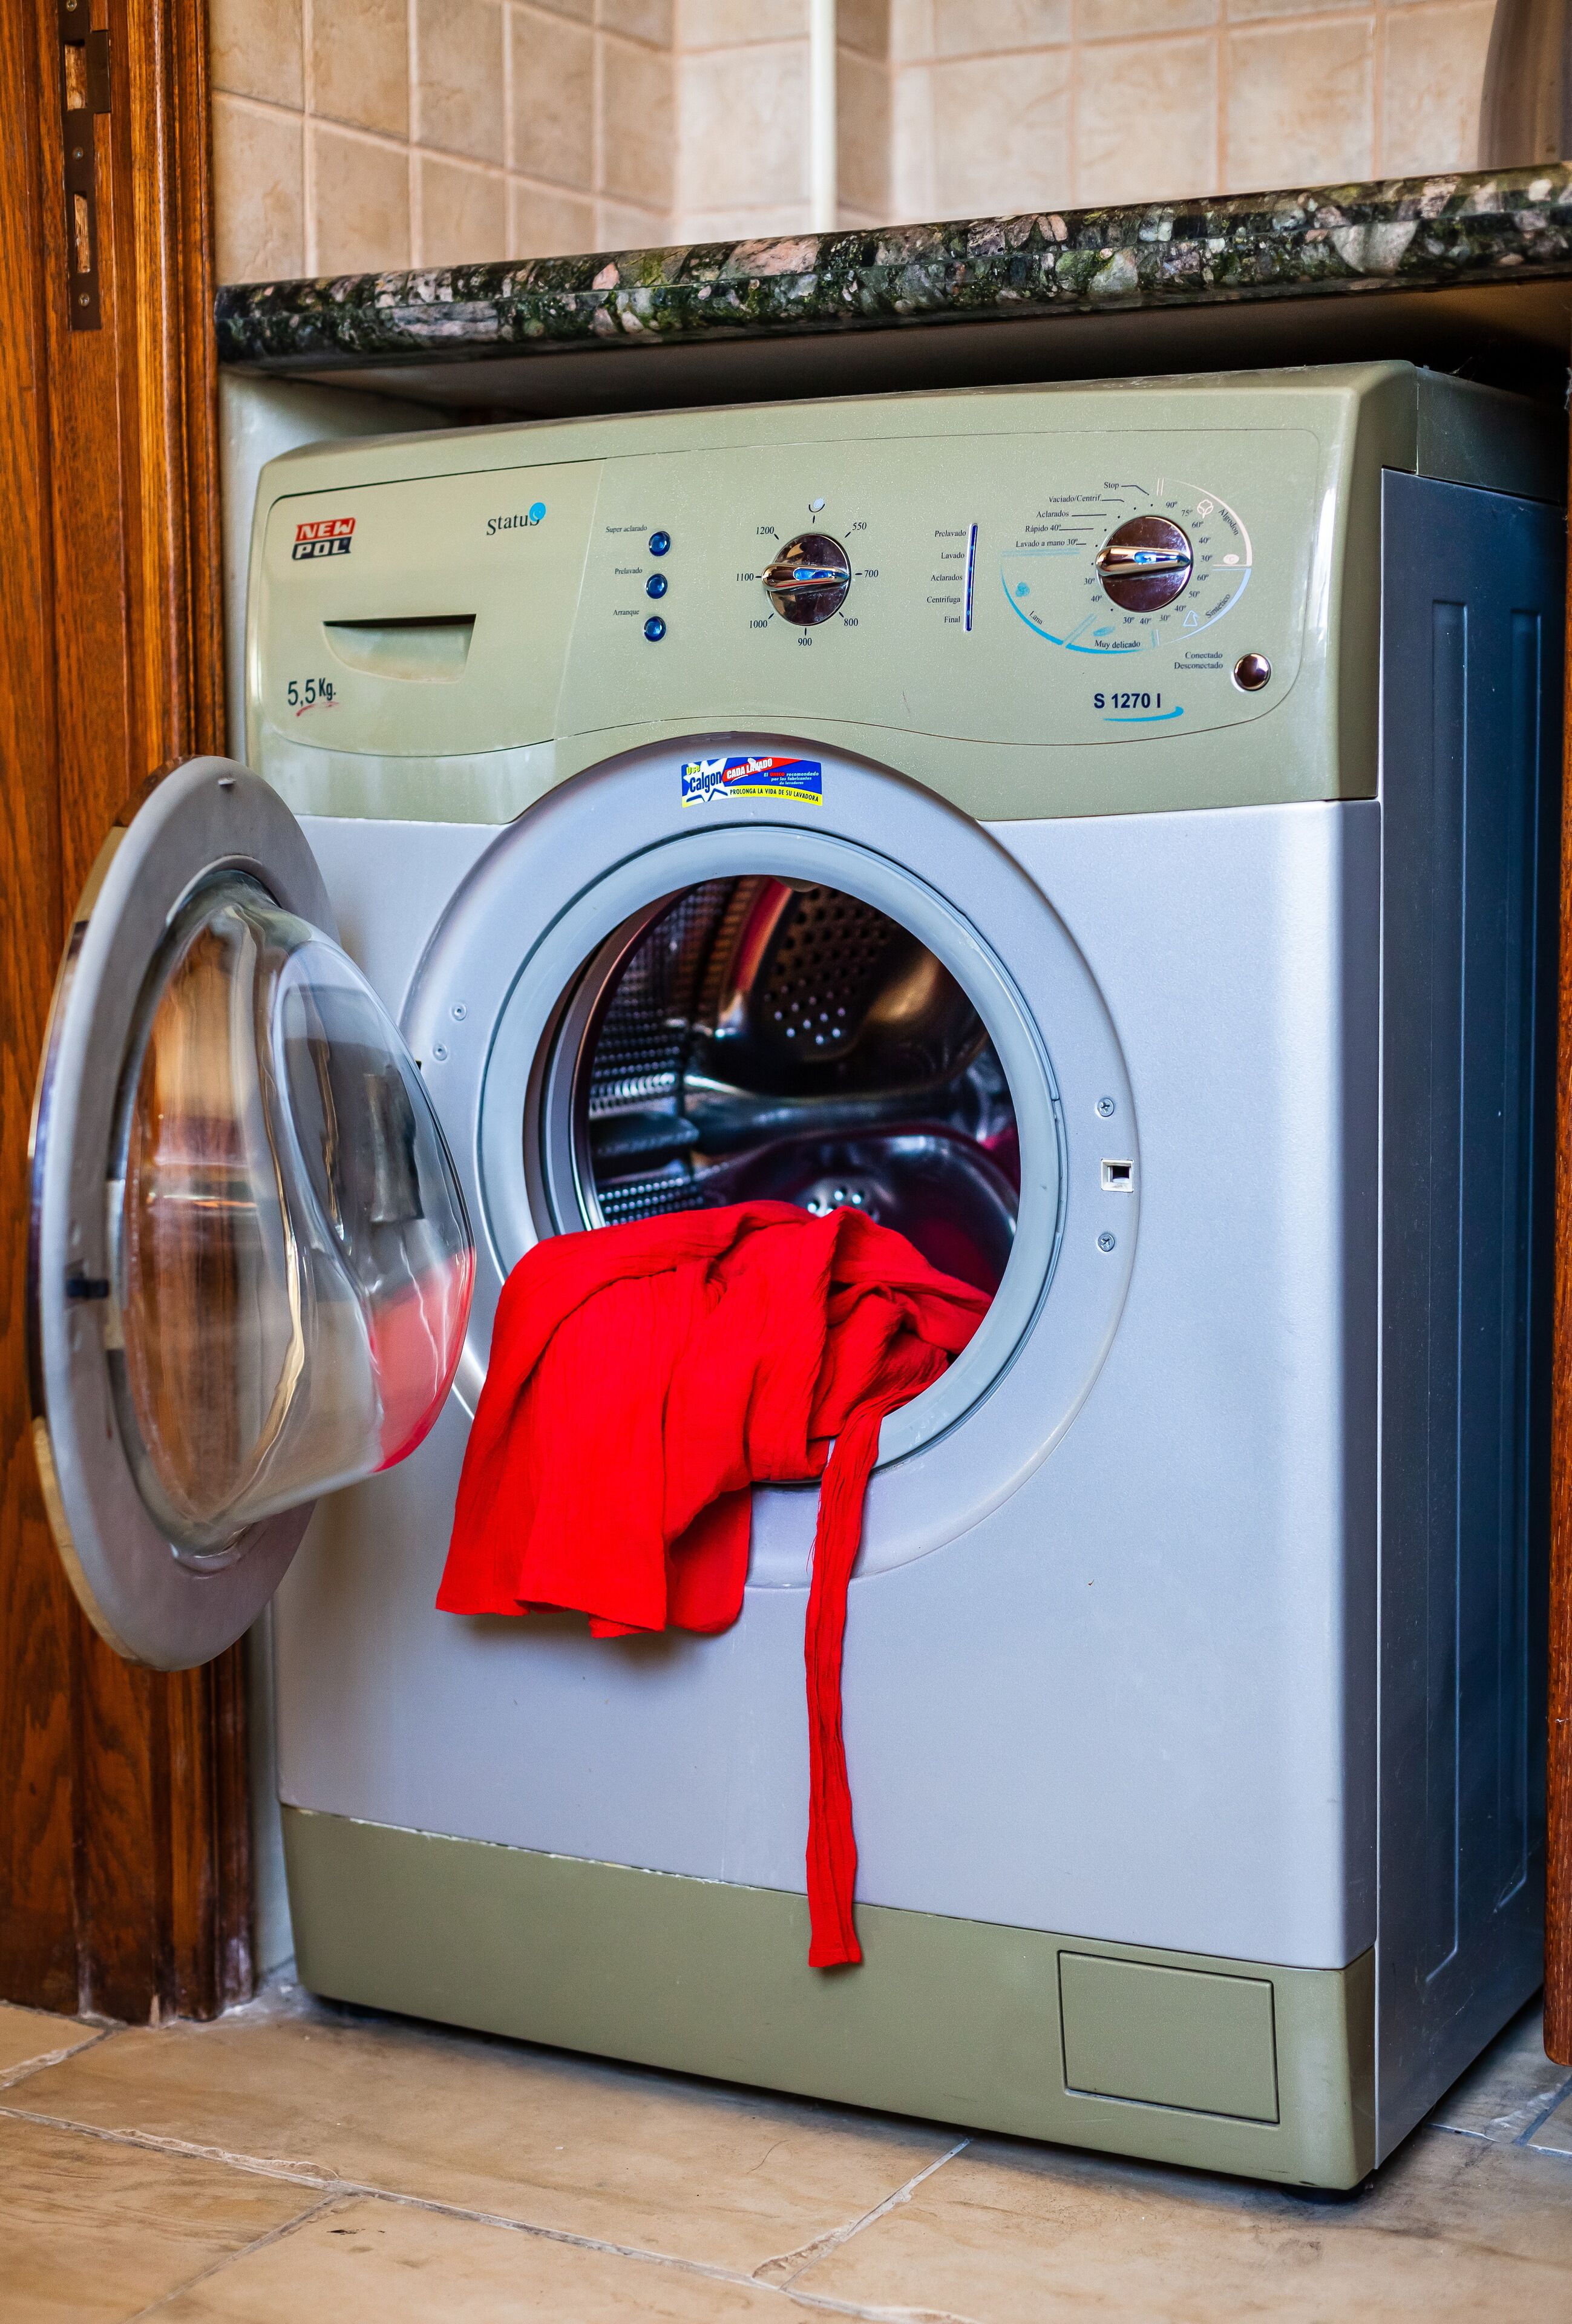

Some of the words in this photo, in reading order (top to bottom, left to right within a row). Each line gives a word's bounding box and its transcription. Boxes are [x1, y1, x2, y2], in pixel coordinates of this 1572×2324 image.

[1104, 482, 1119, 490] Stop
[299, 519, 353, 539] NEW
[756, 526, 775, 535] 1200
[852, 522, 867, 531] 550
[1025, 525, 1048, 534] Rápido
[295, 540, 346, 559] POL
[736, 573, 754, 582] 1100
[1029, 610, 1043, 625] Lana
[750, 620, 768, 629] 1000
[844, 618, 859, 627] 800
[798, 637, 813, 646] 900
[1095, 640, 1110, 649] Muy
[287, 678, 316, 706] 5,5
[1094, 693, 1105, 709] S
[1112, 693, 1150, 709] 1270
[726, 766, 745, 780] CADA
[690, 771, 722, 793] Calgon
[793, 791, 819, 802] LAVADORA
